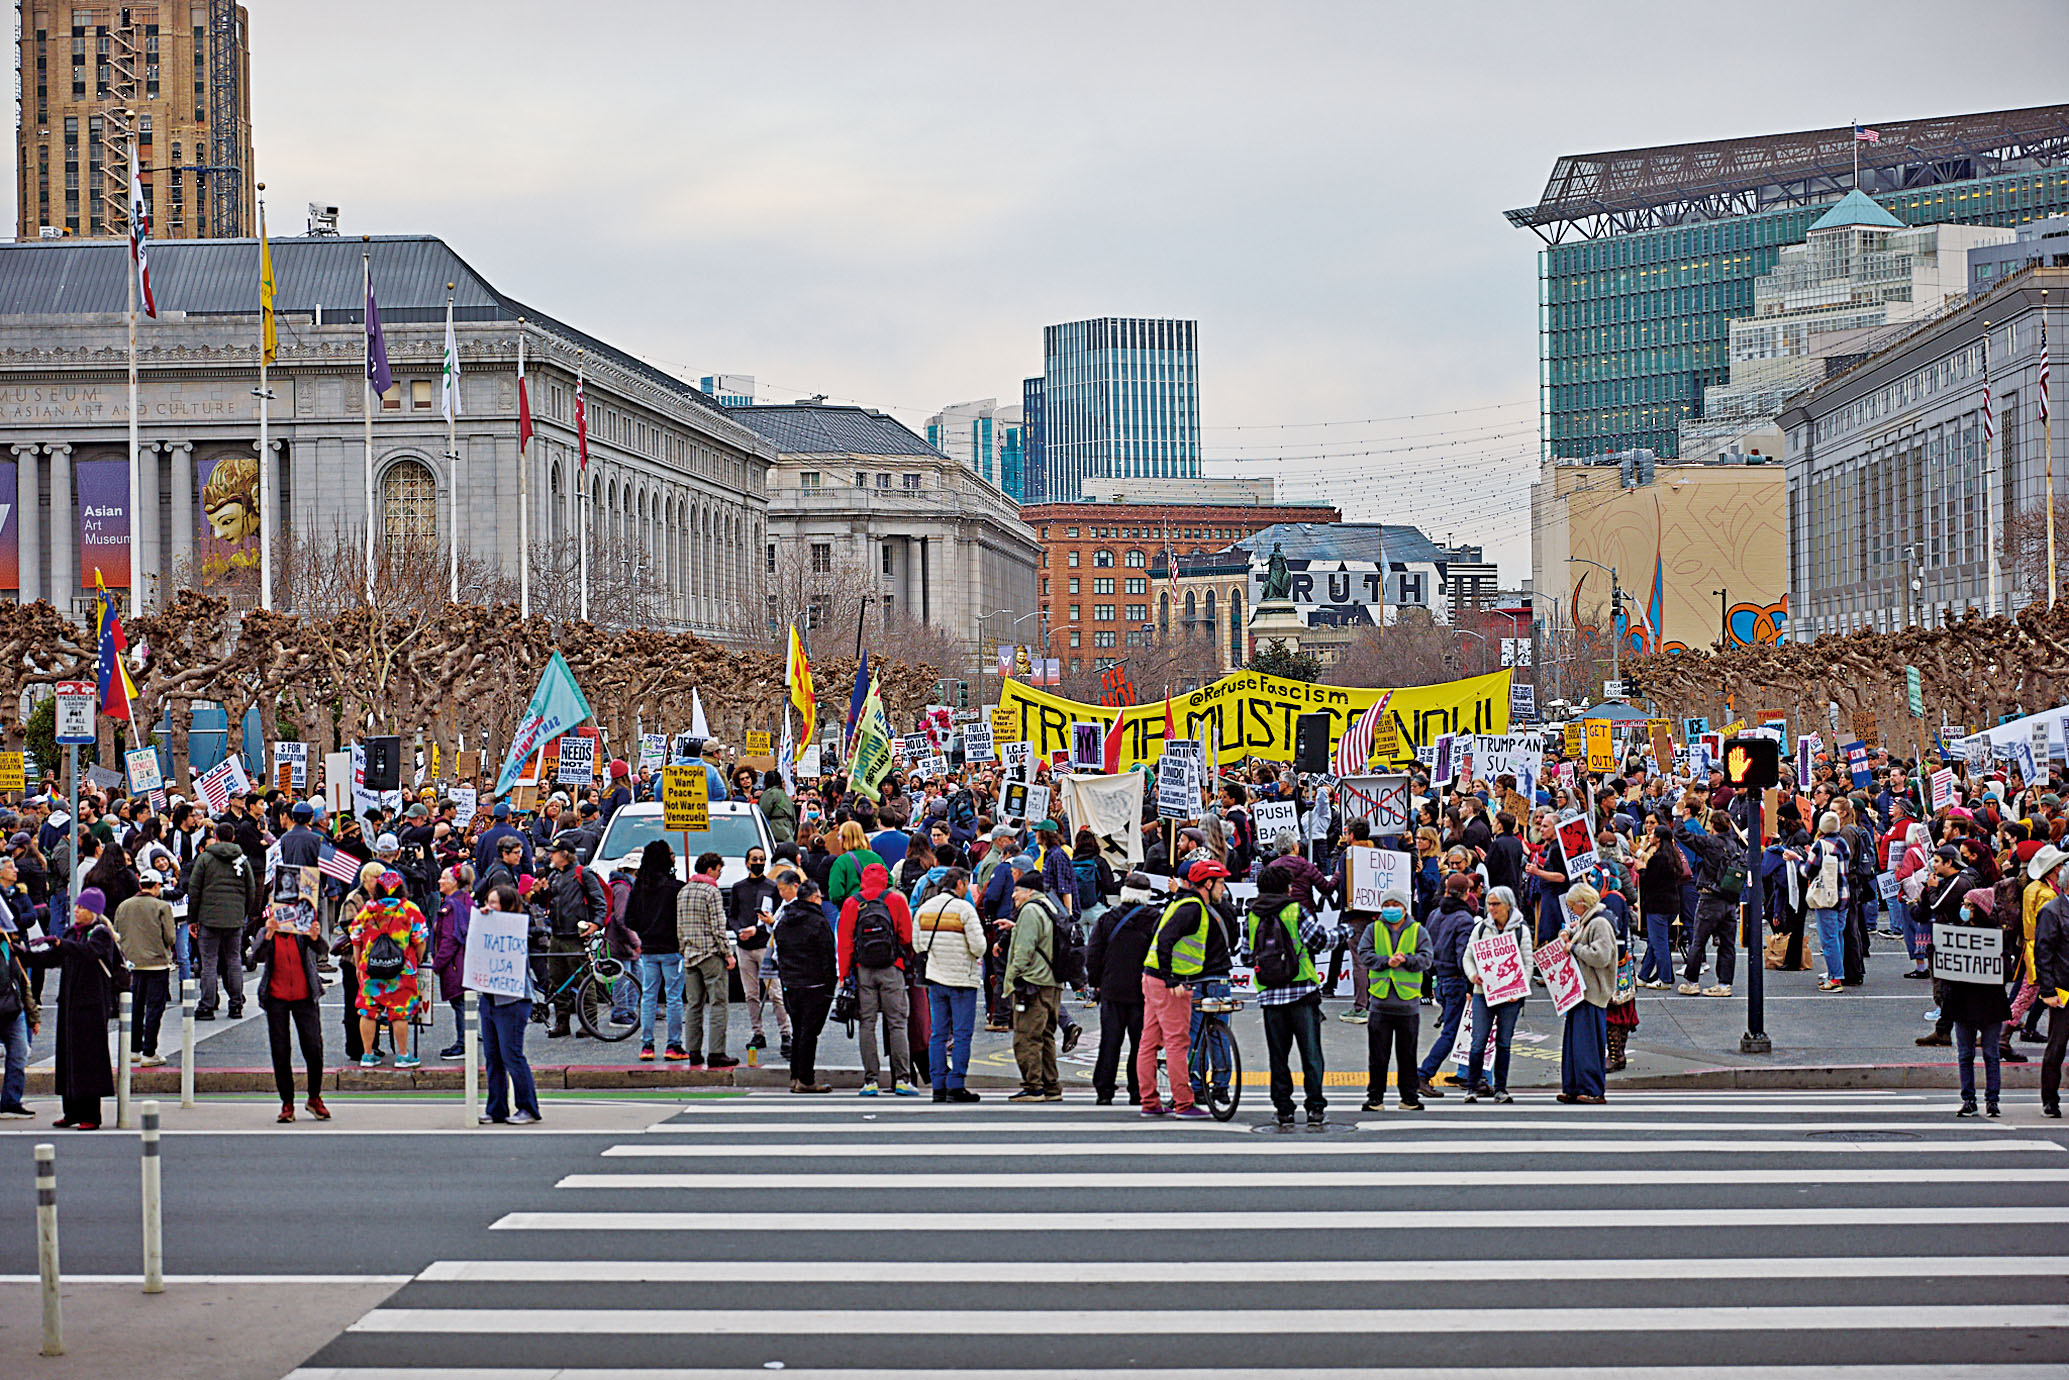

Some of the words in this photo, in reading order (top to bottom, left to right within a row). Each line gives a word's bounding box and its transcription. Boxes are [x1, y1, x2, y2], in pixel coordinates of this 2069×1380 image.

[14, 405, 65, 417] ASIAN
[73, 404, 103, 416] ART
[156, 402, 235, 415] CULTURE
[84, 505, 123, 517] Asian
[84, 519, 102, 531] Art
[85, 533, 132, 545] Museum
[1256, 573, 1421, 603] RUTH
[1757, 710, 1784, 719] TYRANTS
[968, 723, 987, 733] FULLY
[1011, 693, 1166, 759] TRMP
[1187, 697, 1301, 752] MUST
[1589, 725, 1607, 737] GET
[1688, 719, 1704, 735] ICE
[965, 732, 990, 743] FUNDED
[288, 743, 301, 753] FOR
[905, 740, 916, 750] NO
[967, 742, 991, 751] SCHOOLS
[1006, 743, 1030, 754] I.C.E.
[1463, 741, 1473, 752] OUT
[1477, 736, 1516, 752] TRUMP
[275, 752, 306, 762] EDUCATION
[561, 745, 592, 761] NEEDS
[1169, 758, 1187, 767] PUEBLO
[1592, 754, 1612, 767] OUT!
[200, 760, 230, 783] FUCK
[291, 766, 302, 774] FOR
[664, 767, 678, 777] The
[679, 767, 704, 779] People
[1163, 766, 1184, 779] UNIDO
[674, 778, 695, 788] Want
[668, 788, 692, 798] Peace
[665, 801, 678, 811] Not
[679, 801, 695, 811] War
[1344, 787, 1407, 827] KINGS
[665, 811, 706, 822] Venezuela
[1256, 805, 1293, 820] PUSH
[1370, 852, 1396, 870] END
[483, 933, 527, 955] TRAITORS
[1473, 939, 1493, 953] ICE
[1492, 933, 1513, 948] OUT
[1942, 931, 1995, 950] ICE=
[1476, 951, 1493, 961] FOR
[1493, 944, 1517, 957] GOOD
[1532, 948, 1548, 963] ICE
[1548, 940, 1564, 956] OUT
[489, 959, 513, 974] USA
[1538, 960, 1552, 972] FOR
[1935, 952, 2001, 975] GESTAPO
[1496, 989, 1520, 999] PROTECT
